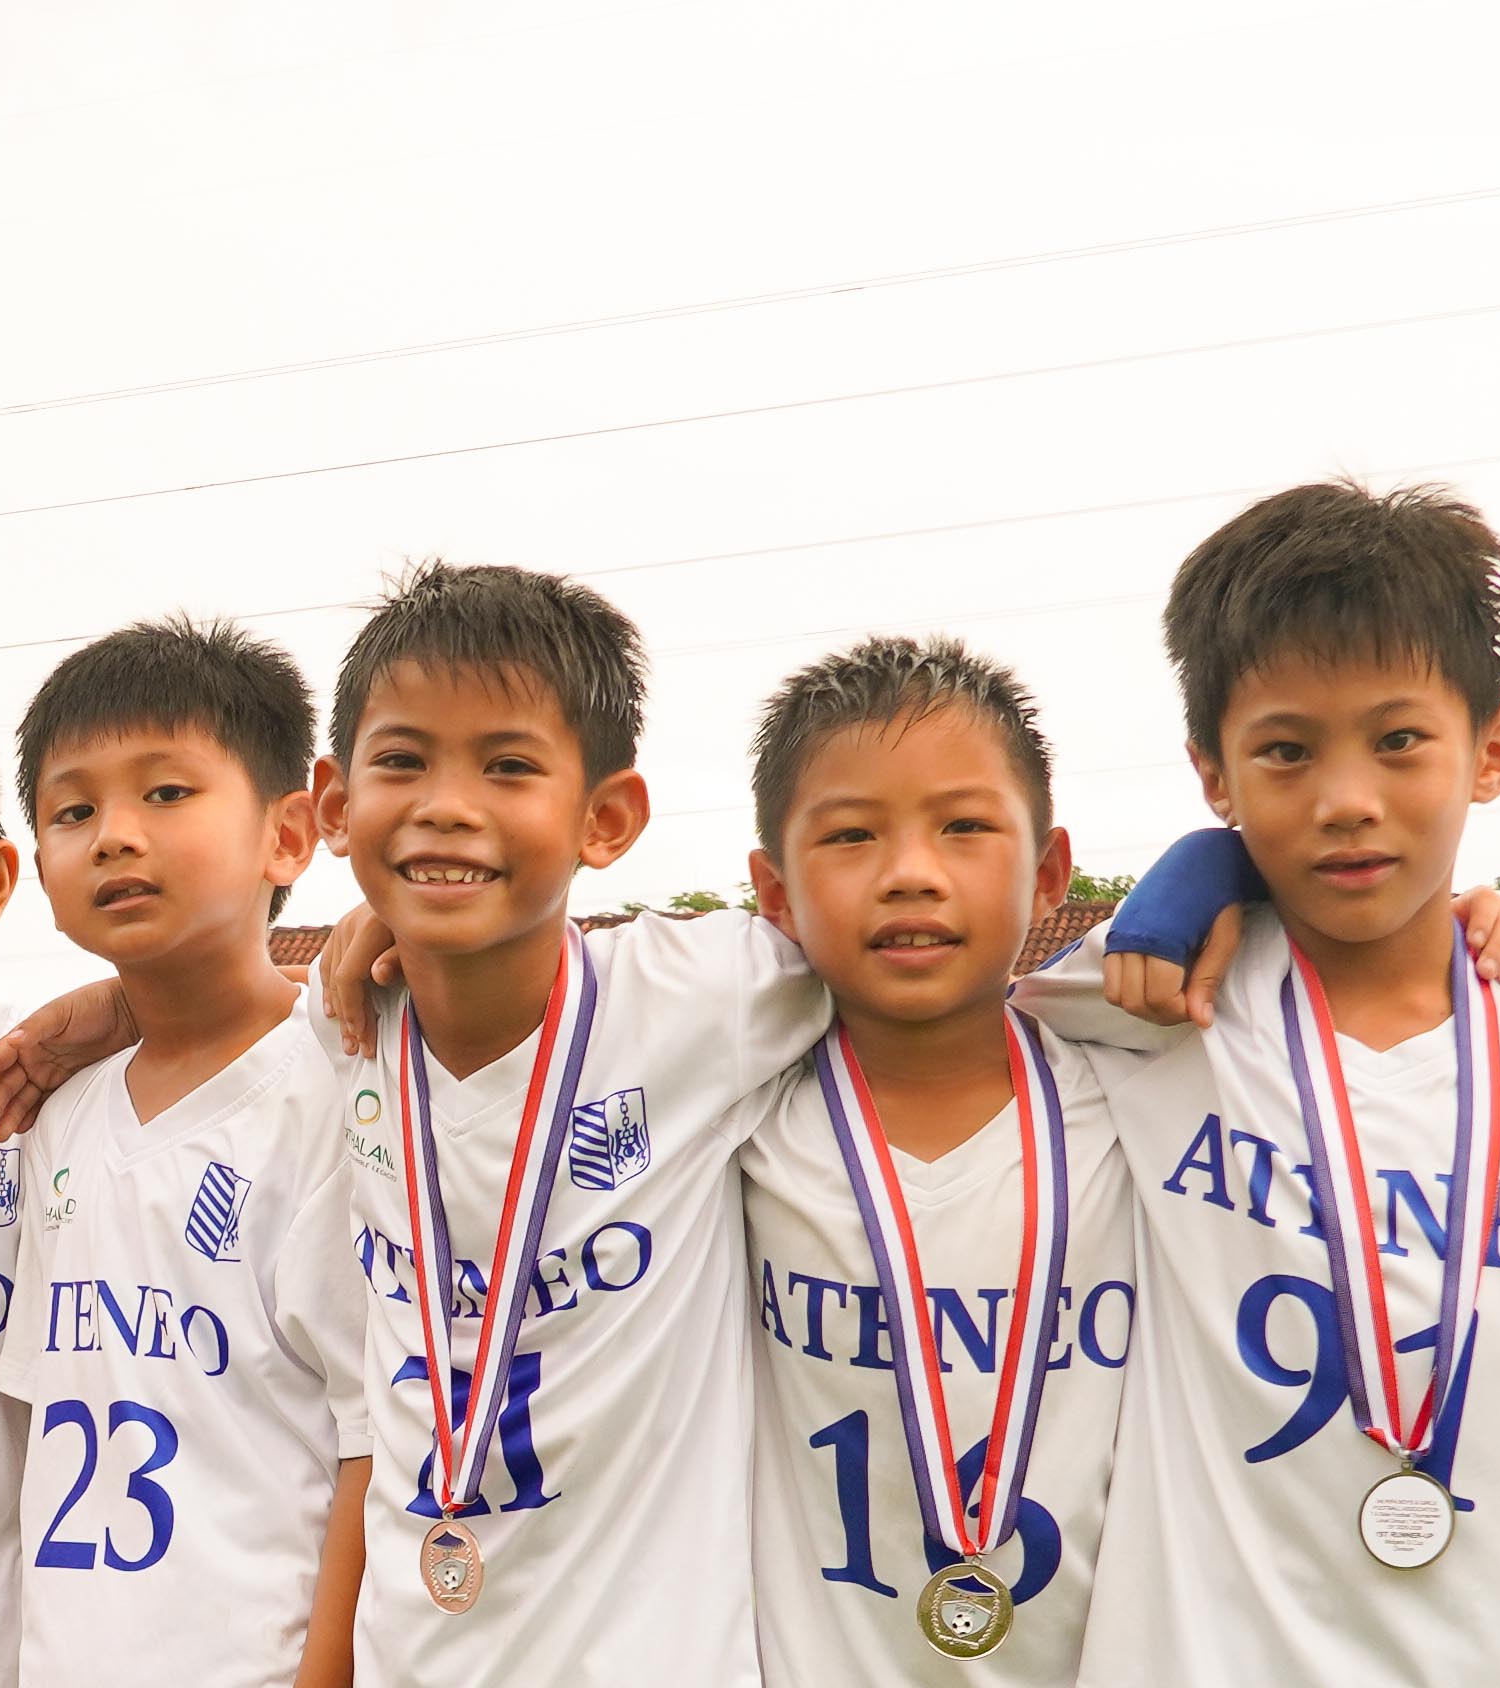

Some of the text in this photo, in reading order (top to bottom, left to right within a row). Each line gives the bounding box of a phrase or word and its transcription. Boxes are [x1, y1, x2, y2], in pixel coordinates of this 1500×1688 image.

[39, 1279, 230, 1377] TENEO
[353, 1220, 653, 1318] ATNEO
[33, 1399, 179, 1572] 23
[391, 1351, 562, 1520] 21
[808, 1409, 1063, 1608] 16
